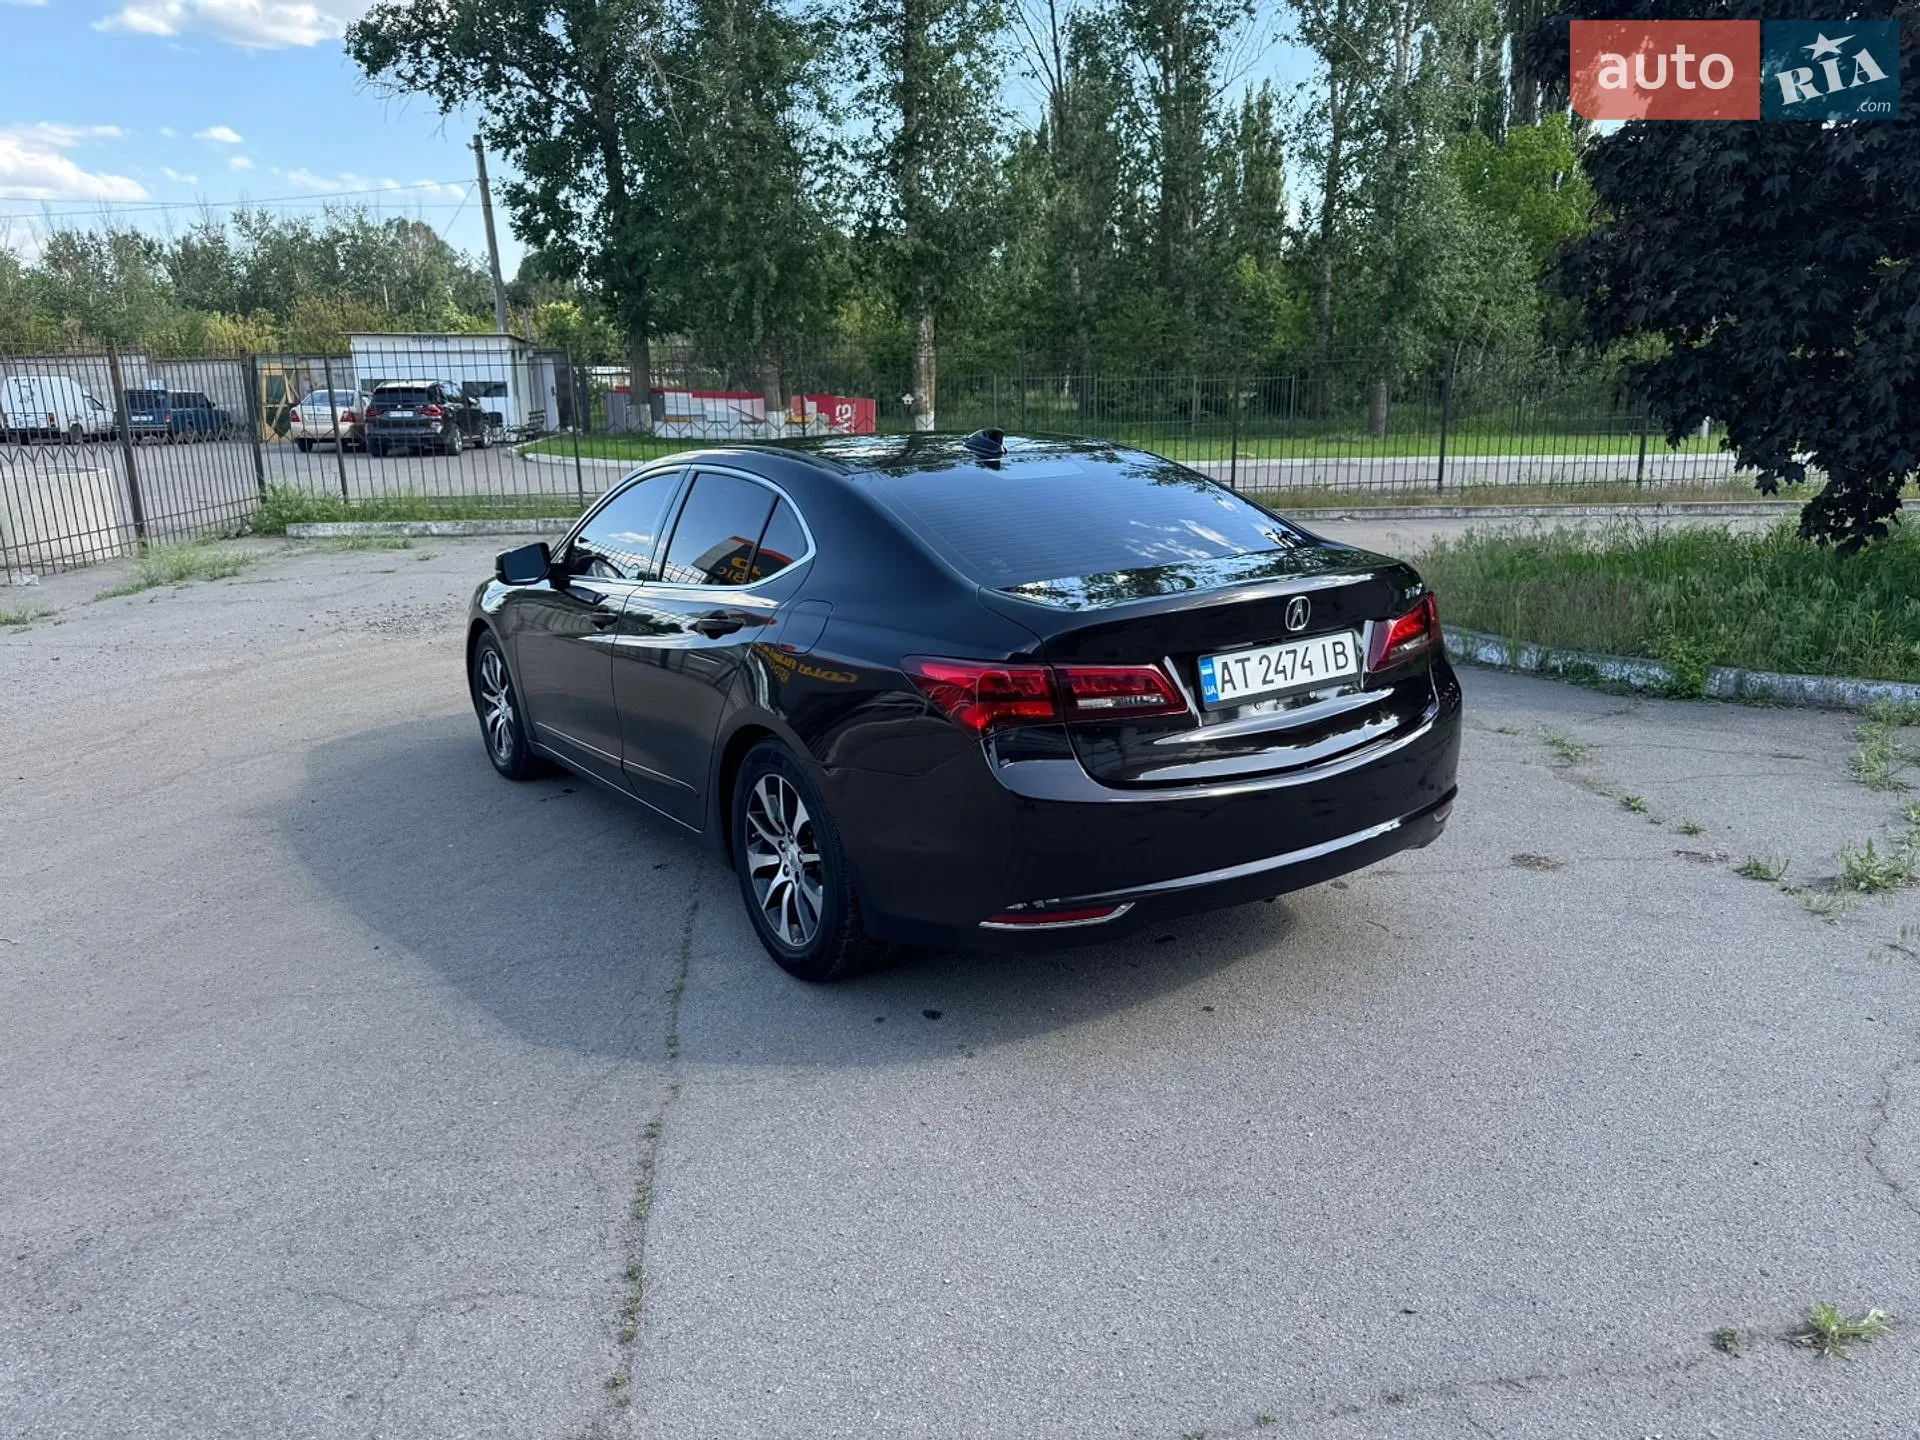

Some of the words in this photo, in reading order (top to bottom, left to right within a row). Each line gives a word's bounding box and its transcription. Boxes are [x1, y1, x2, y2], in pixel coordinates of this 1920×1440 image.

[1220, 657, 1251, 694] AT
[1259, 646, 1314, 685] 2474
[1321, 640, 1349, 673] IB
[1205, 686, 1217, 695] UA
